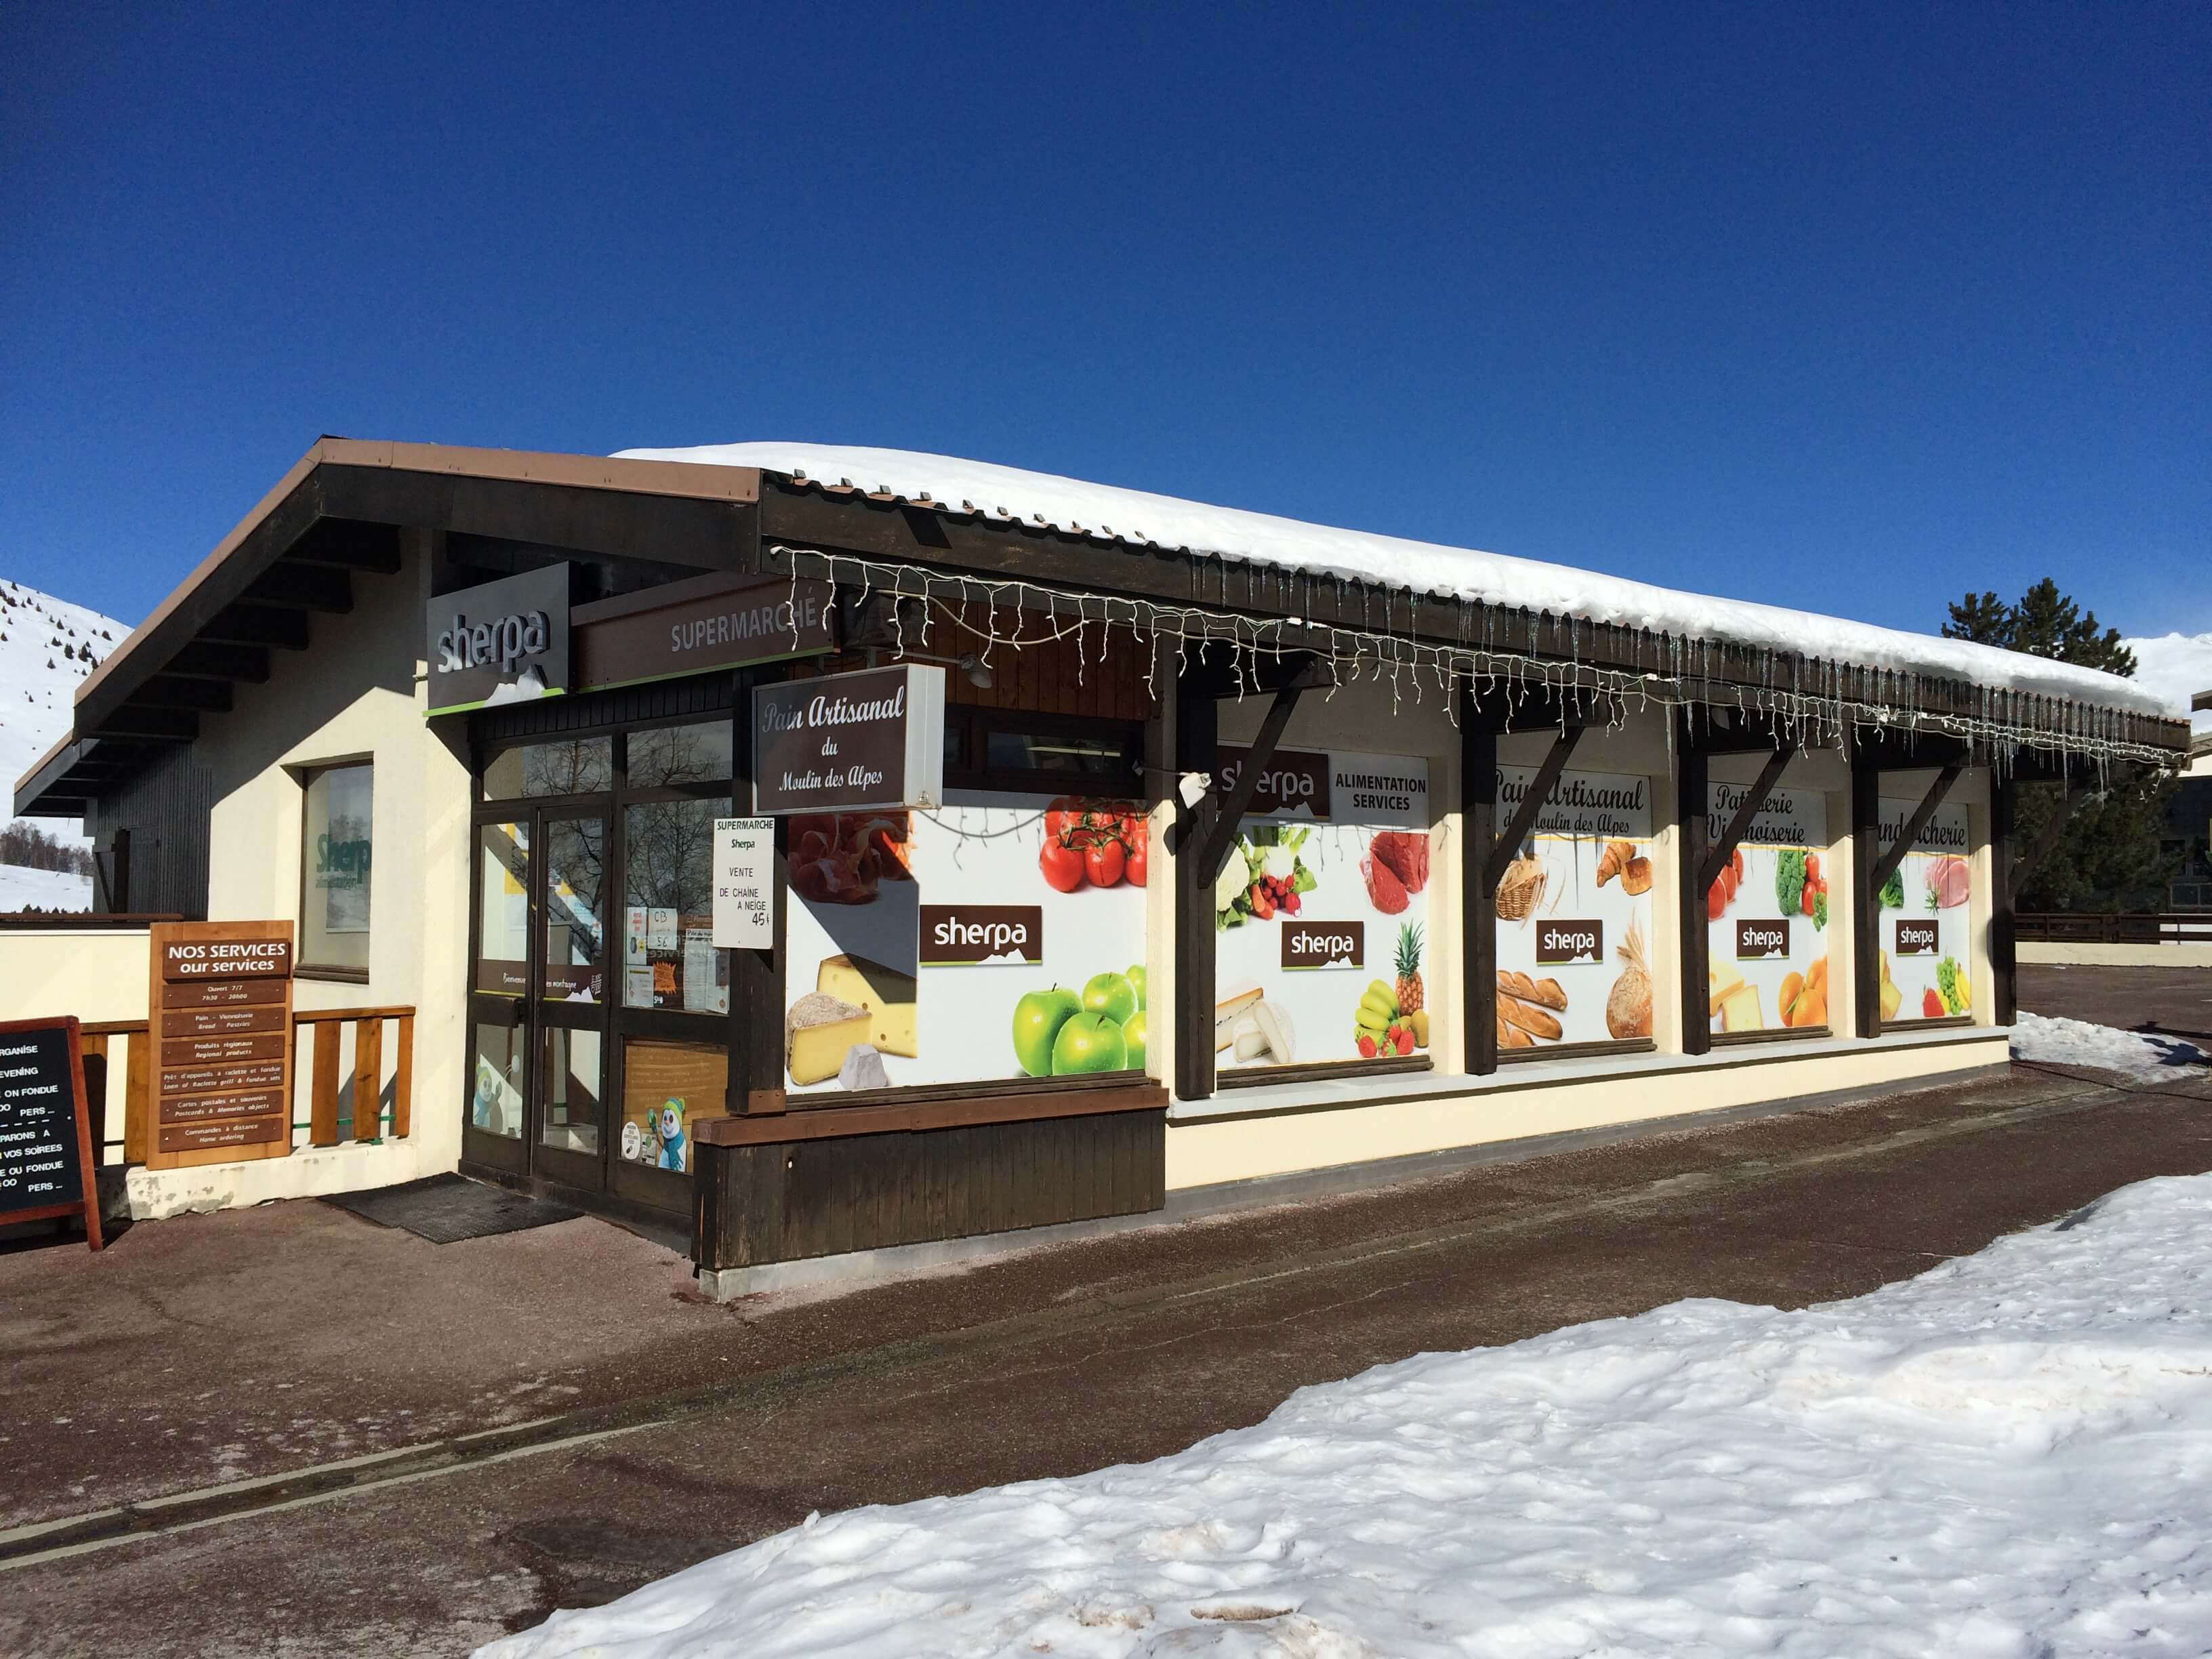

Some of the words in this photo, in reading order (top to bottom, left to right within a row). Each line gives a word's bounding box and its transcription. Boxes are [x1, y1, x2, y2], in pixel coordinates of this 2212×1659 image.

[671, 586, 817, 653] SUPERMARCHÉ
[438, 610, 551, 673] sherpa
[762, 702, 804, 733] Pain
[808, 685, 905, 728] Artisanal
[821, 736, 839, 756] du
[779, 769, 822, 792] Moulin
[824, 768, 844, 788] des
[848, 765, 883, 792] Alpes
[1221, 760, 1314, 802] serpa
[1335, 773, 1427, 794] ALIMENTATION
[1353, 794, 1410, 811] SERVICES
[717, 819, 773, 830] SUPERMARCHE
[1574, 813, 1593, 832] des
[1597, 813, 1630, 838] Alpes
[1707, 813, 1805, 843] Vinoiserie
[731, 838, 755, 851] Sherpa
[729, 867, 754, 878] VENTE
[720, 887, 729, 897] DE
[737, 901, 742, 910] A
[933, 916, 1027, 949] sherpa
[1742, 926, 1784, 949] sherpa
[1900, 926, 1934, 946] sherpa
[1290, 930, 1354, 957] sherpa
[1543, 928, 1595, 953] sherpa
[169, 945, 206, 959] NOS
[209, 943, 286, 958] SERVICES
[180, 962, 209, 973] our
[211, 958, 274, 972] services
[195, 1050, 222, 1059] Regional
[226, 1049, 252, 1057] products
[4, 1089, 19, 1098] ON
[21, 1085, 59, 1097] FONDUE
[201, 1099, 226, 1107] postales
[240, 1094, 267, 1103] souvenirs
[20, 1107, 46, 1117] PERS
[174, 1109, 205, 1117] Postcards
[217, 1105, 245, 1113] Memories
[248, 1103, 270, 1111] objects
[43, 1129, 51, 1137] A
[184, 1127, 222, 1136] Commandes
[232, 1123, 258, 1131] distance
[219, 1133, 245, 1141] ordering
[3, 1149, 23, 1158] VOS
[8, 1166, 22, 1175] OU
[26, 1160, 64, 1173] FONDUE
[28, 1182, 54, 1193] PERS
